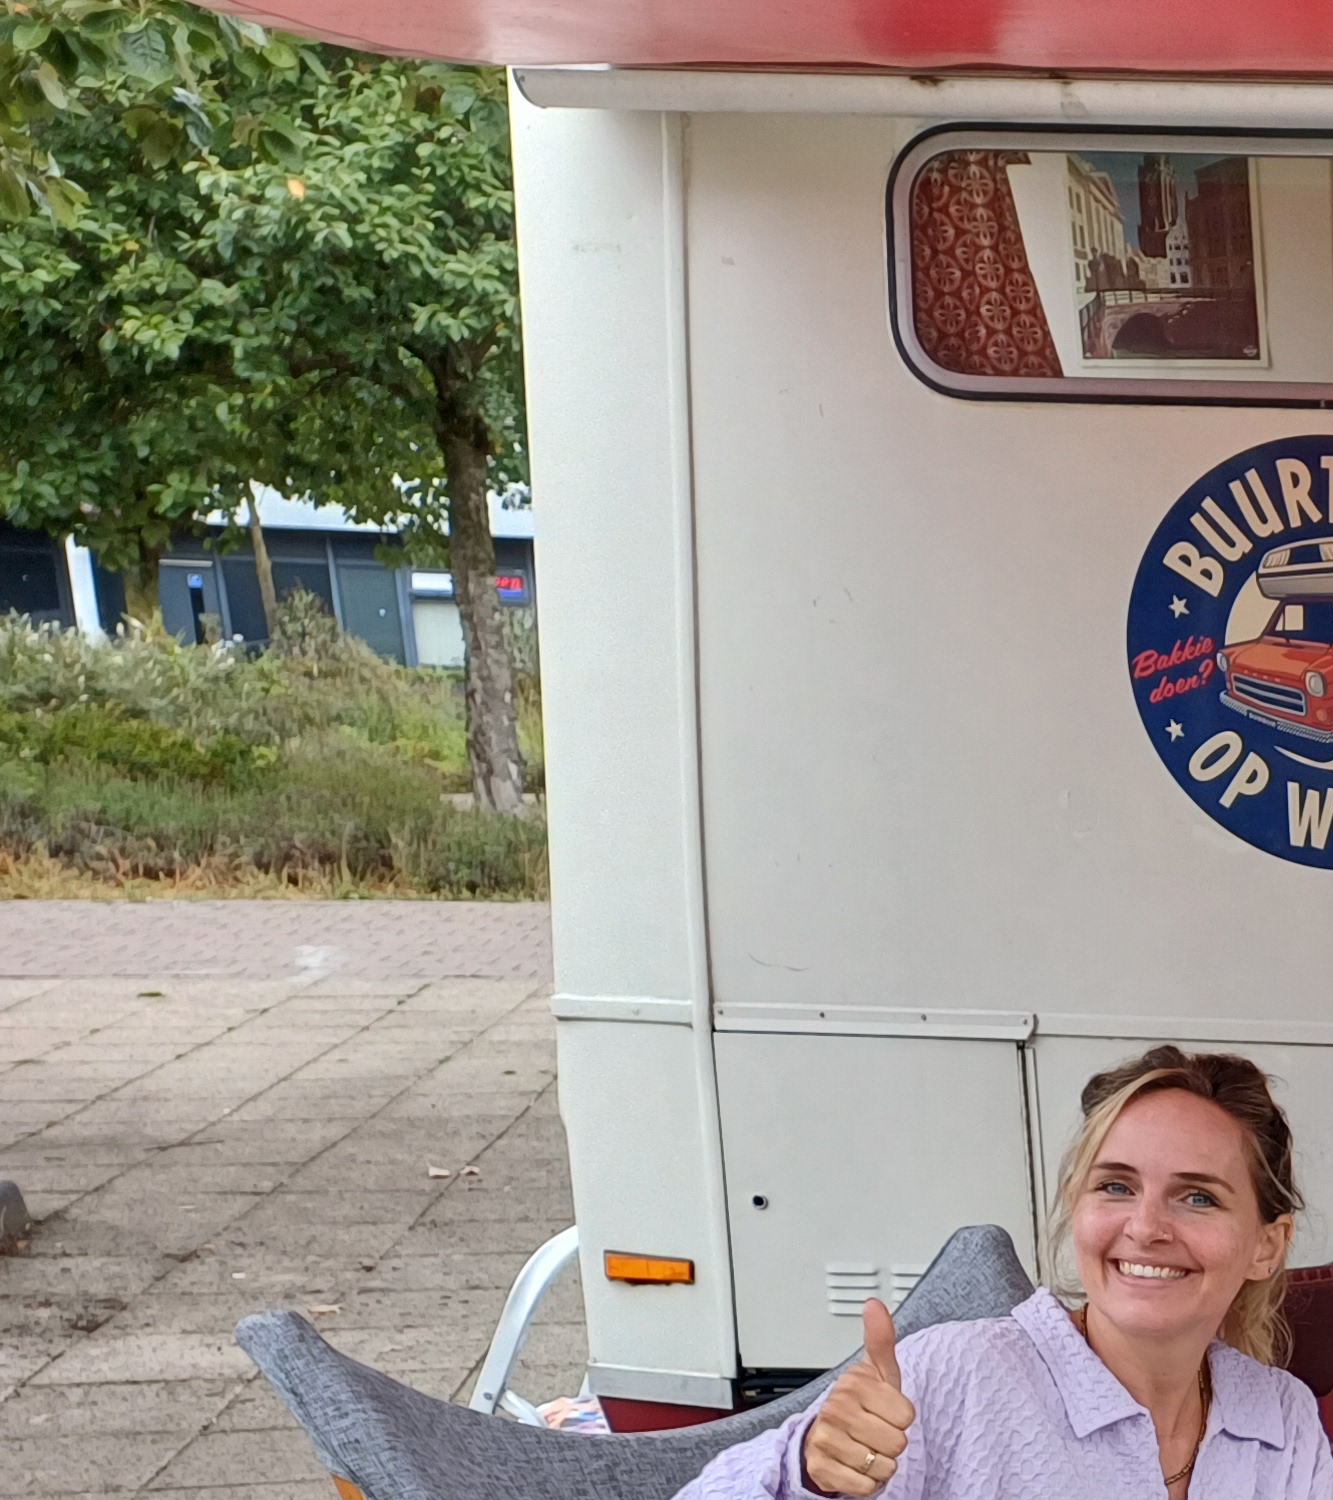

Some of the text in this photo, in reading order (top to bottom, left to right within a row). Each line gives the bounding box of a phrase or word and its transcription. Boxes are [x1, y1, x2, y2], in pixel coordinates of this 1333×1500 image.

[1133, 636, 1214, 679] Bakkie
[1149, 659, 1214, 703] doen?
[1188, 730, 1271, 809] OP
